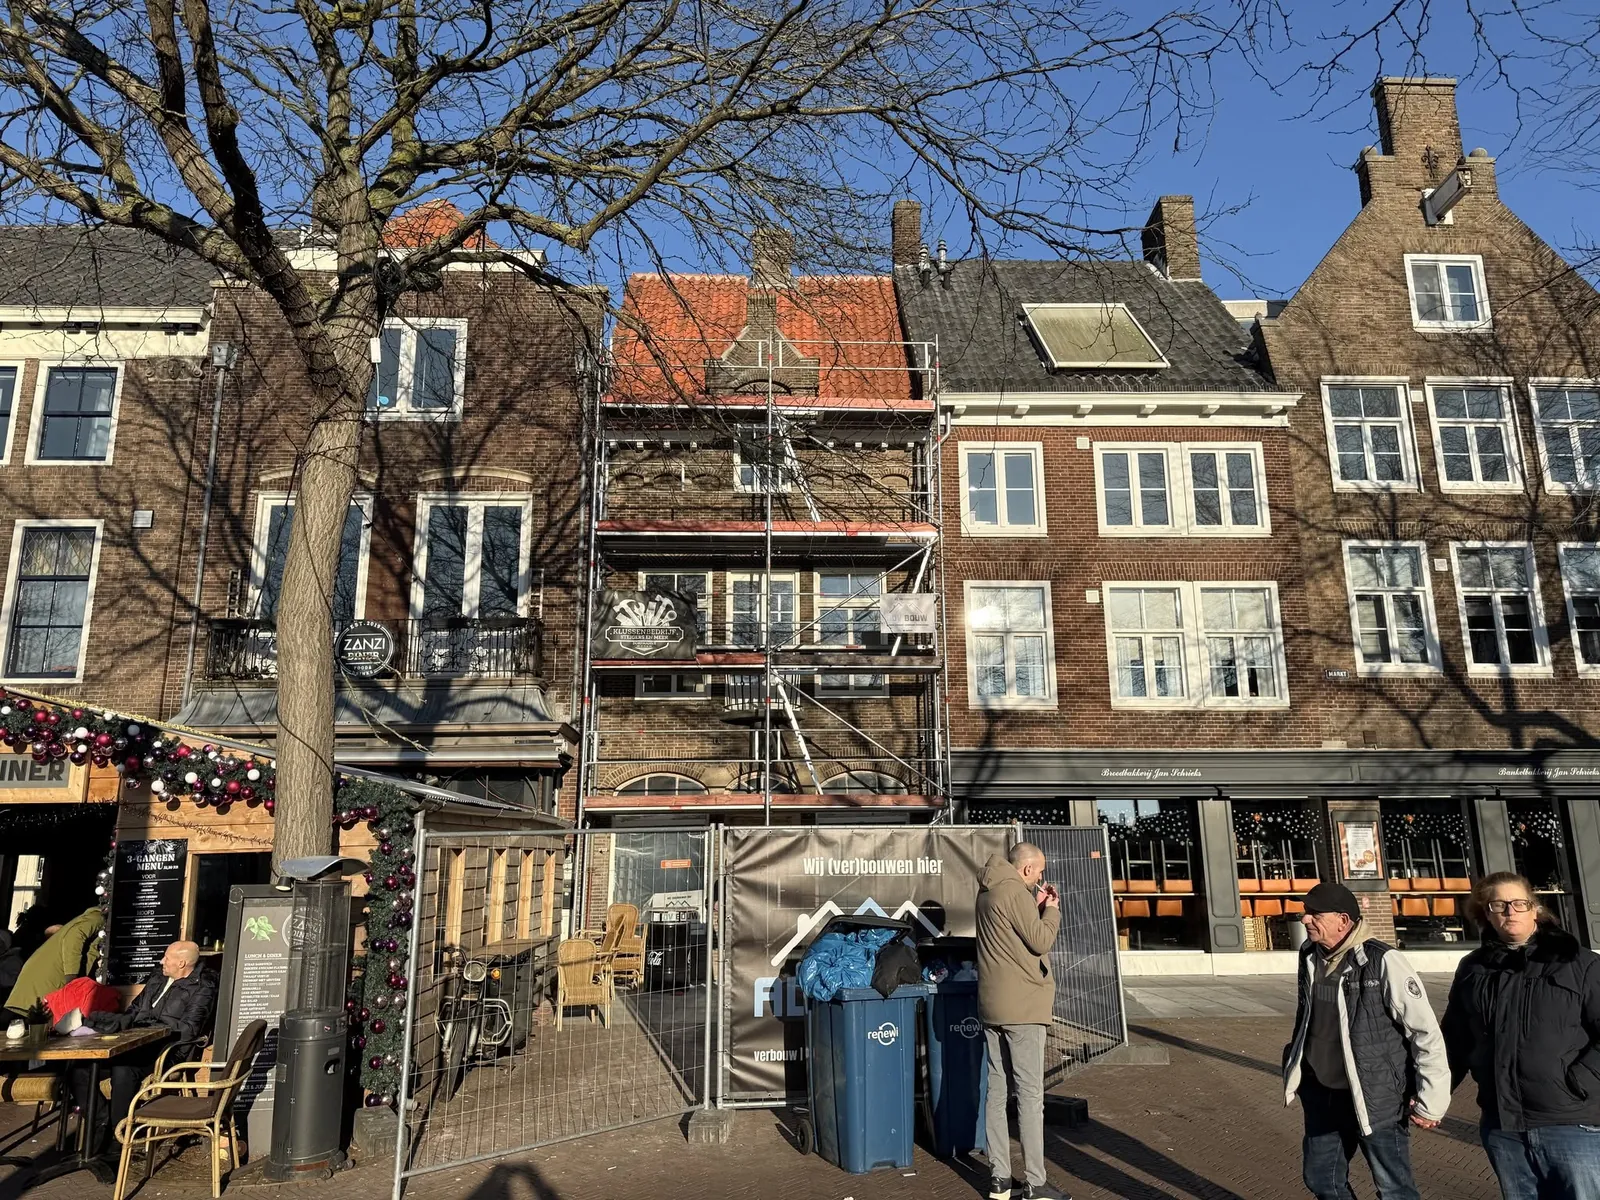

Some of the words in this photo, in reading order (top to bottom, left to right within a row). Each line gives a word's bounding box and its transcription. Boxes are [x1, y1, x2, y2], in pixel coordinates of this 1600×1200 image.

[344, 638, 386, 650] ZANZI
[1152, 768, 1169, 780] Jan
[1553, 767, 1569, 779] Jan
[126, 853, 176, 864] 3-GANGEN
[136, 862, 164, 871] MENU
[803, 856, 825, 877] Wij
[828, 857, 914, 876] (ver)bouwen
[916, 856, 943, 875] hier
[867, 1026, 899, 1040] renewi
[949, 1023, 984, 1033] renewi
[753, 1049, 798, 1063] verbouw
